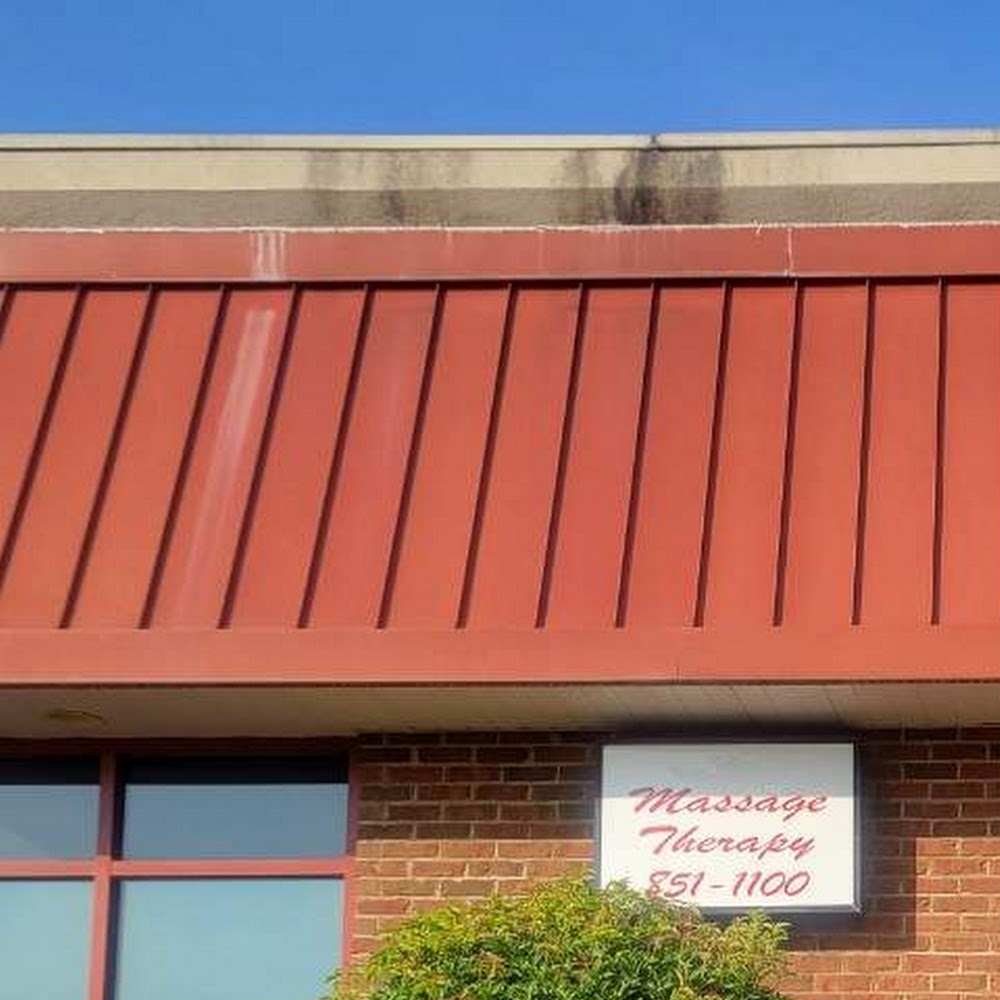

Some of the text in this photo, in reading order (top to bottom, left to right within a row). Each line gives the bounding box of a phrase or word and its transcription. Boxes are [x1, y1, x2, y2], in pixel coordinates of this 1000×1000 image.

[629, 786, 827, 822] Massage
[639, 826, 815, 860] Therapy
[647, 870, 811, 898] 851-1100
